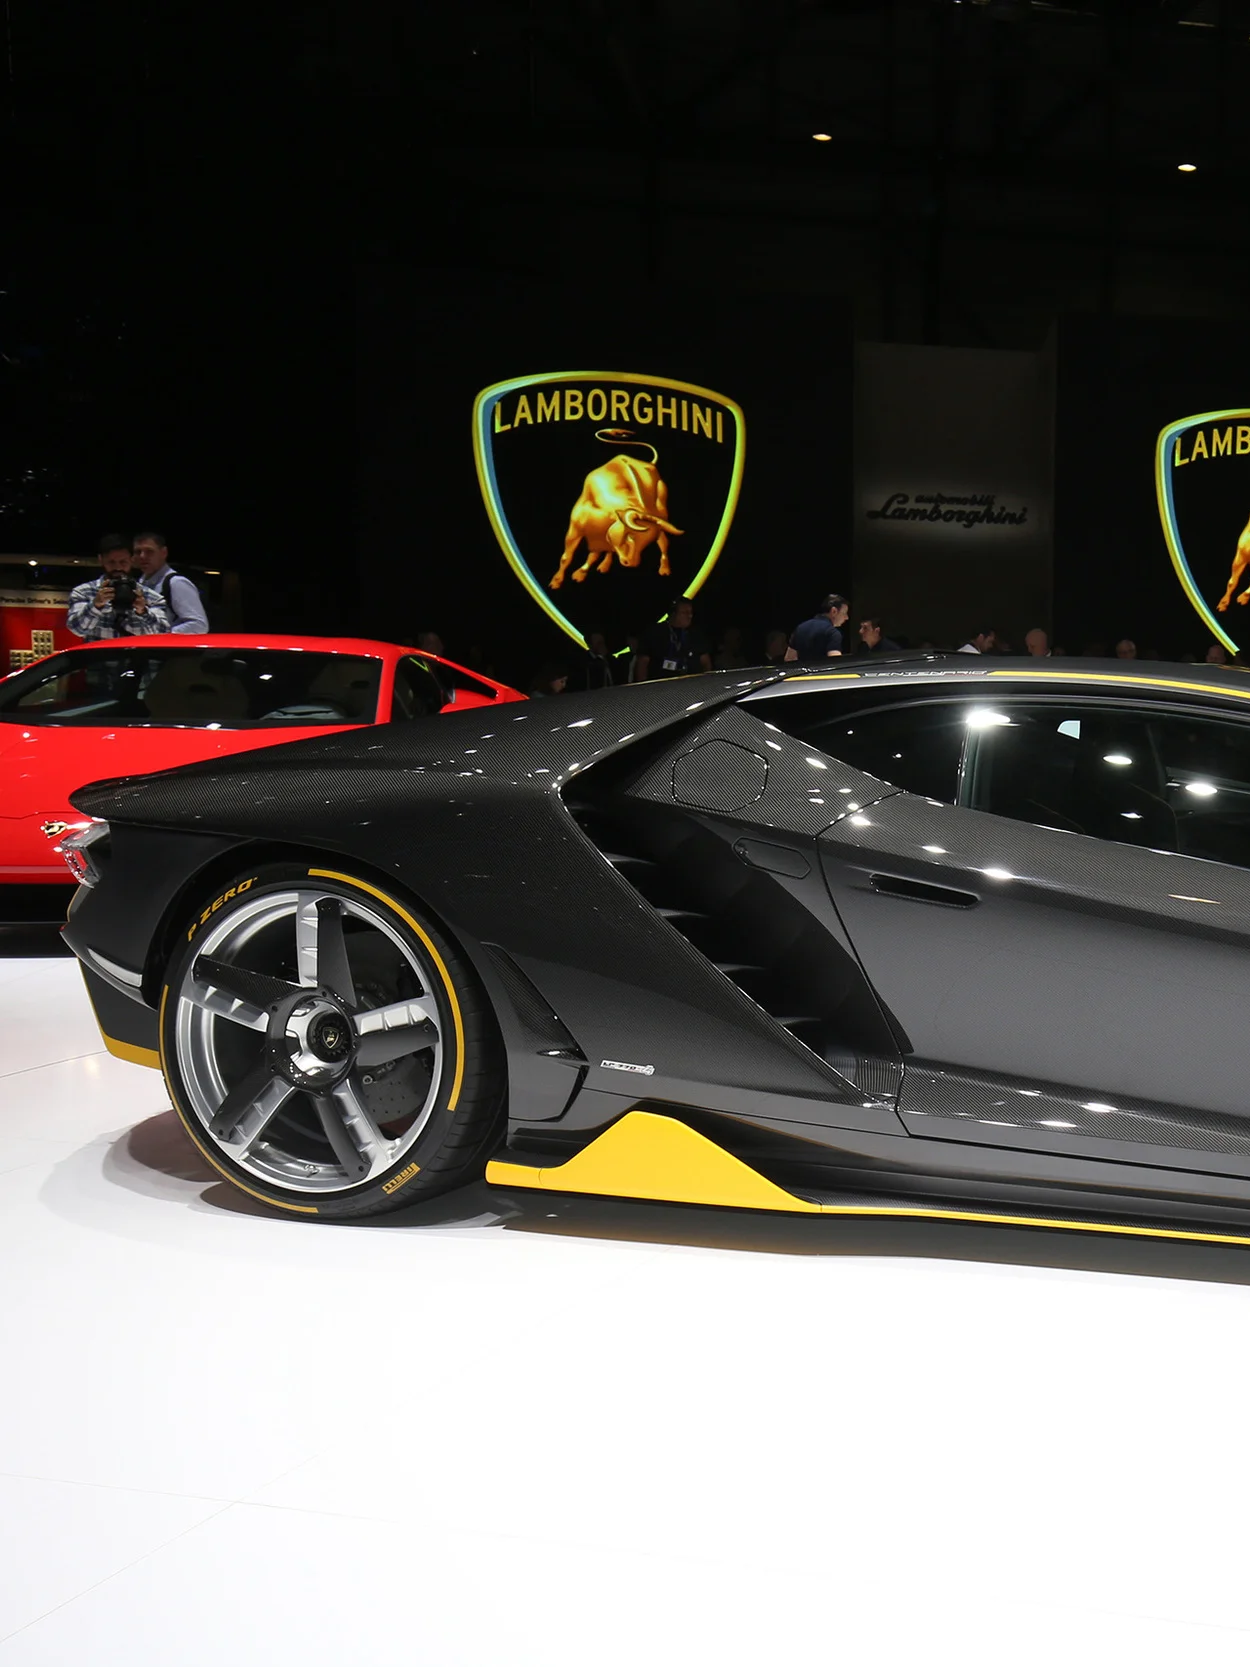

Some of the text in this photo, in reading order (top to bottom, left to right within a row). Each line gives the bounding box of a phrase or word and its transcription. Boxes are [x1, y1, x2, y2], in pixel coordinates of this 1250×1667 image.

[494, 388, 724, 444] LAMBORGHINI
[866, 493, 1028, 529] Lamborghini
[187, 878, 253, 942] P ZERO
[381, 1161, 421, 1195] PIRELLI
